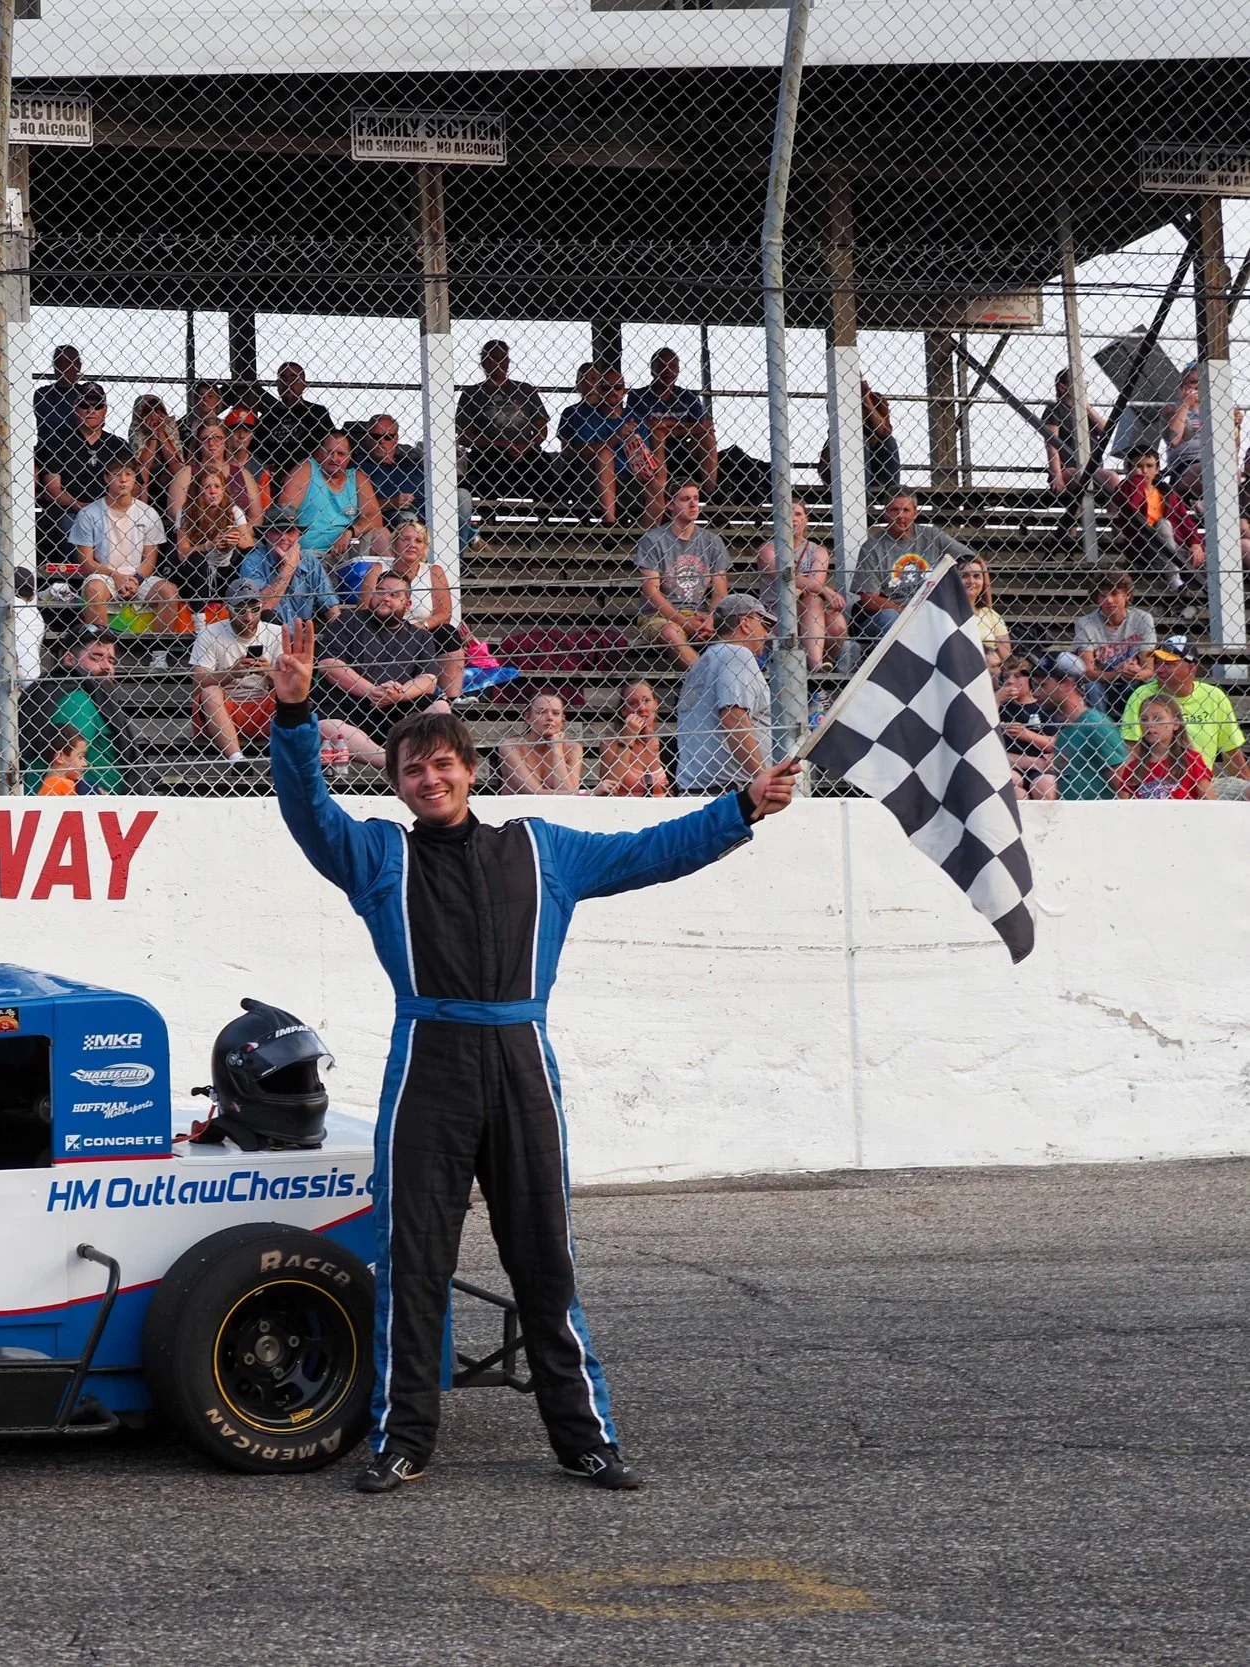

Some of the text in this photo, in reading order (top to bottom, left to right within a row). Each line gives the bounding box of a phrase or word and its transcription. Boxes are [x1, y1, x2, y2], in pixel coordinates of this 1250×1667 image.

[10, 100, 87, 122] SECTION
[20, 122, 36, 134] NO
[38, 123, 88, 137] ALCOHOL
[357, 117, 500, 140] FAMILY SECTION
[358, 139, 373, 151] NO
[376, 139, 428, 152] SMOKING
[437, 141, 451, 153] NO
[454, 142, 502, 156] ALCOHOL
[94, 1033, 142, 1046] MKR
[83, 1069, 147, 1080] HARTFORD
[72, 1101, 128, 1113] HOFFMAN
[103, 1099, 154, 1119] Motorsports
[83, 1136, 163, 1147] CONCRETE
[46, 1178, 101, 1213] HM
[260, 1249, 351, 1287] RACER
[205, 1408, 342, 1460] AMERICAN
